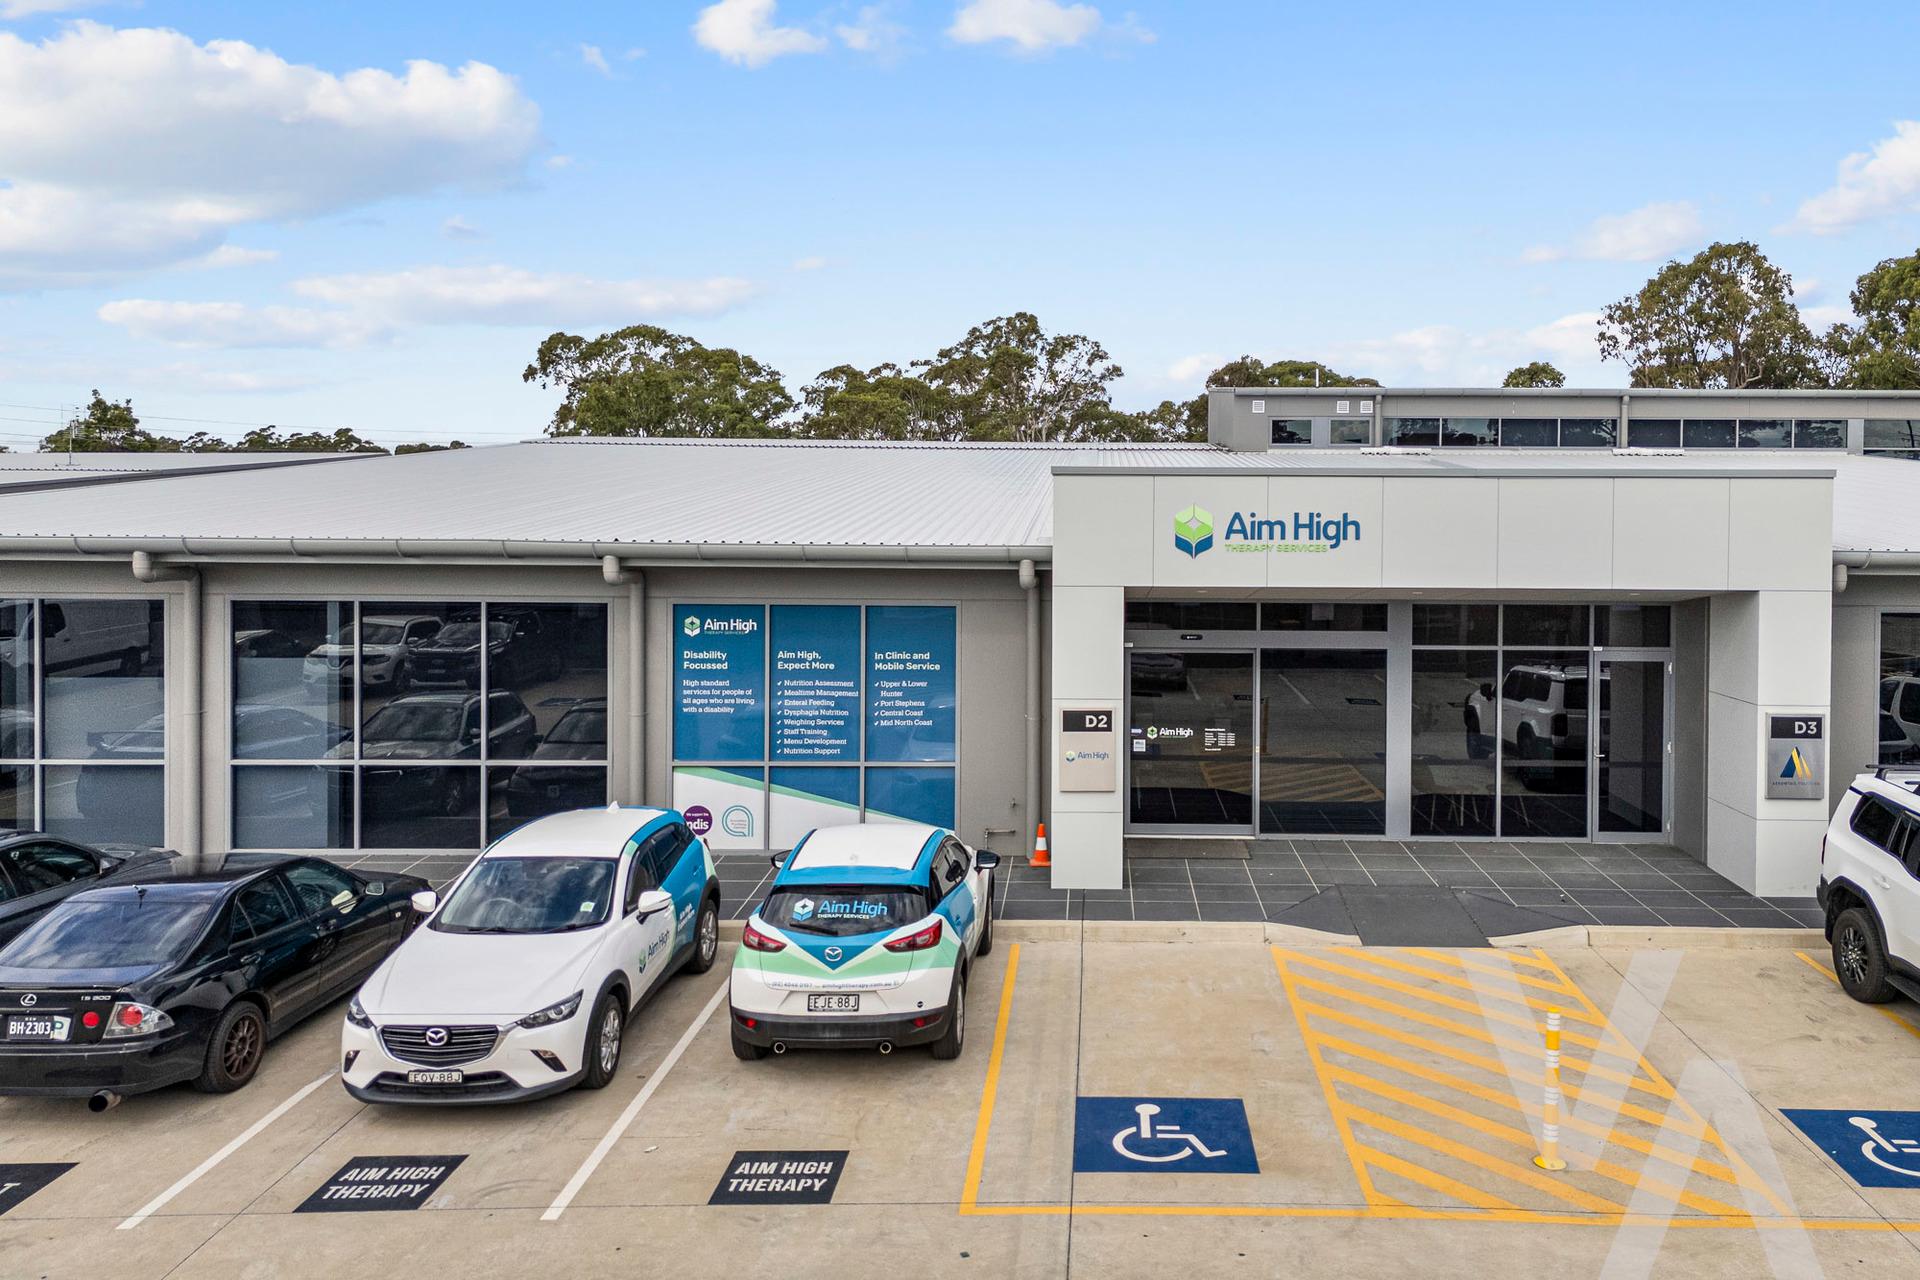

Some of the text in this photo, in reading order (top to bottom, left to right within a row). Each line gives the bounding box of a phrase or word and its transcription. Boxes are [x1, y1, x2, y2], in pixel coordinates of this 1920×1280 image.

[1225, 512, 1360, 549] Aim High
[1224, 544, 1328, 552] THERAPY SERVICES
[704, 618, 757, 634] Aim High
[683, 651, 727, 660] Disability
[777, 651, 821, 660] Aim High,
[874, 652, 930, 660] In Clinic and
[777, 662, 810, 671] Expect
[874, 662, 941, 671] Mobile Service
[1085, 715, 1107, 728] D2
[1794, 721, 1817, 734] D3
[1159, 728, 1175, 736] Aim
[1176, 728, 1193, 738] High
[804, 738, 847, 746] Development
[1093, 752, 1109, 760] High
[686, 818, 709, 831] ndis
[819, 900, 888, 918] Aim High
[338, 1166, 446, 1181] AIM HIGH
[734, 1161, 833, 1175] AIM HIGH
[322, 1183, 431, 1199] THERAPY
[728, 1179, 827, 1192] THERAPY
